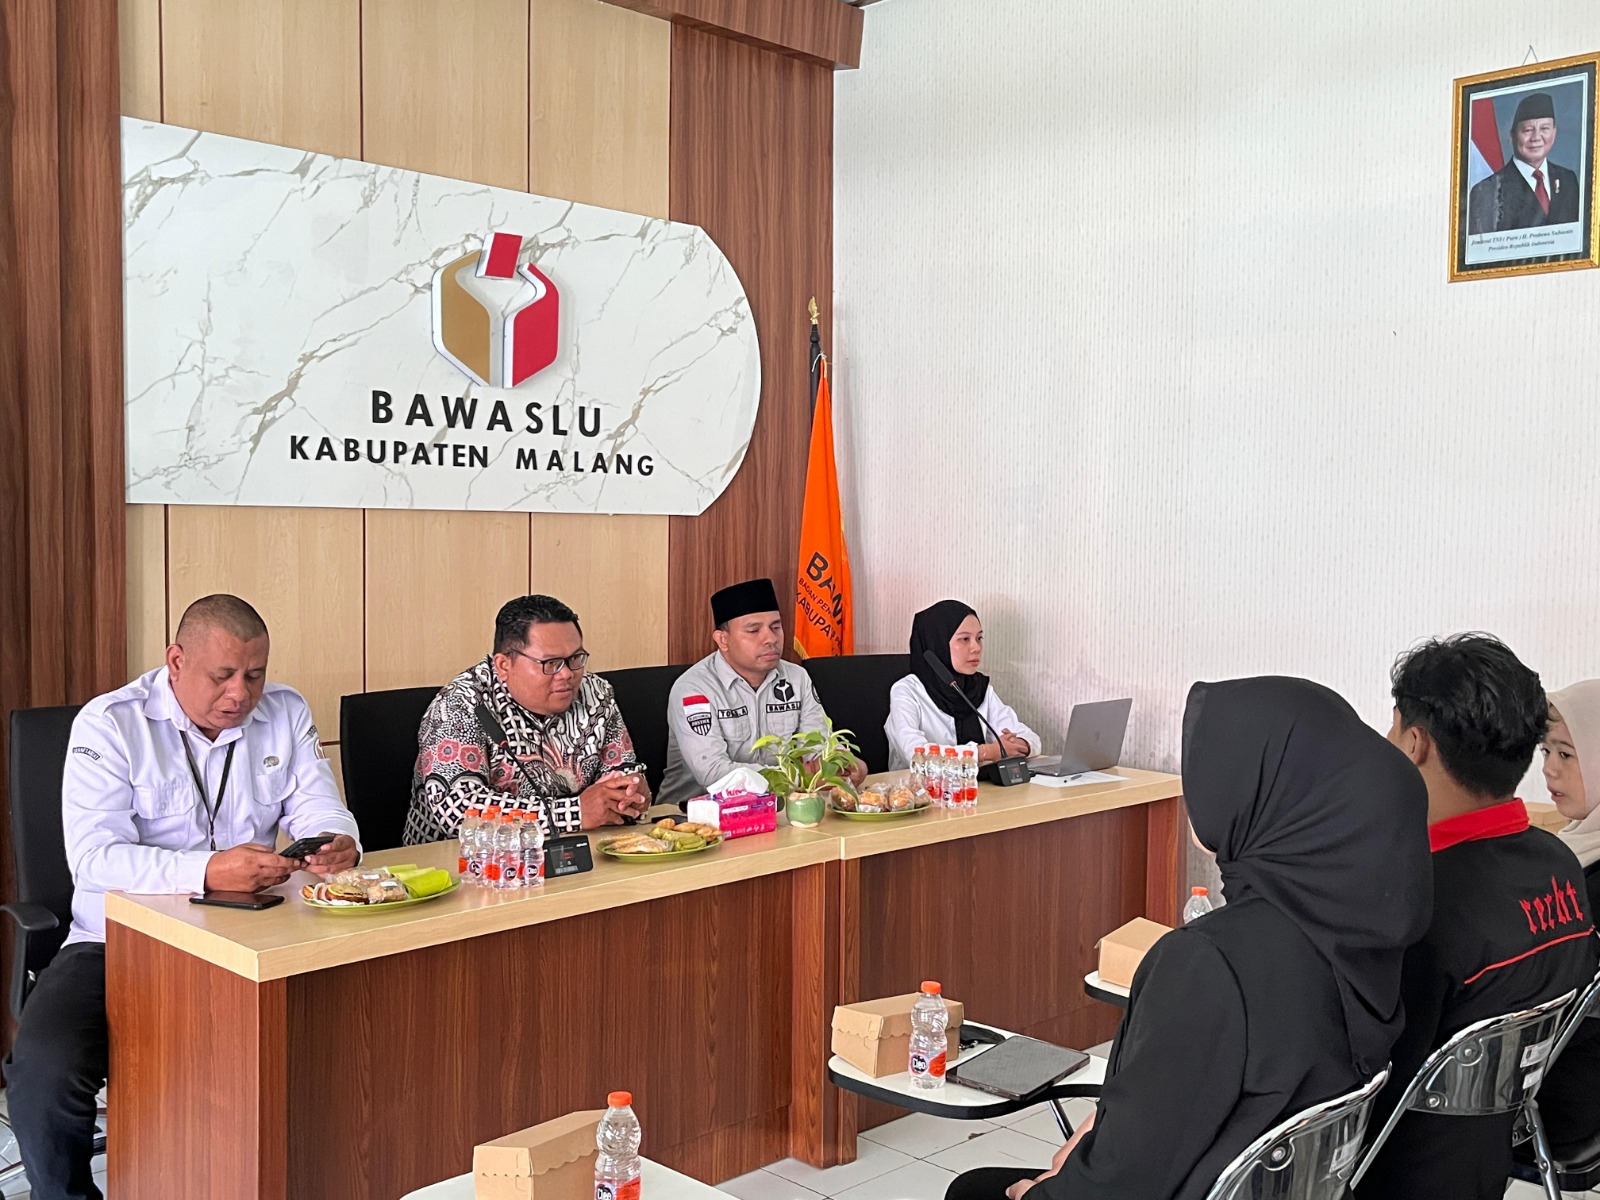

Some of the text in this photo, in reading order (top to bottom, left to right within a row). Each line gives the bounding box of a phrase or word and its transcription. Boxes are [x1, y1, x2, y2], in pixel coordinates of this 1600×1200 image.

[1488, 244, 1508, 252] Presiden
[1509, 242, 1530, 250] Republik
[1529, 231, 1551, 239] Prabowo
[371, 389, 601, 437] BAWASLU
[289, 435, 654, 476] KABUPATEN MALANG
[798, 577, 818, 602] BADAN
